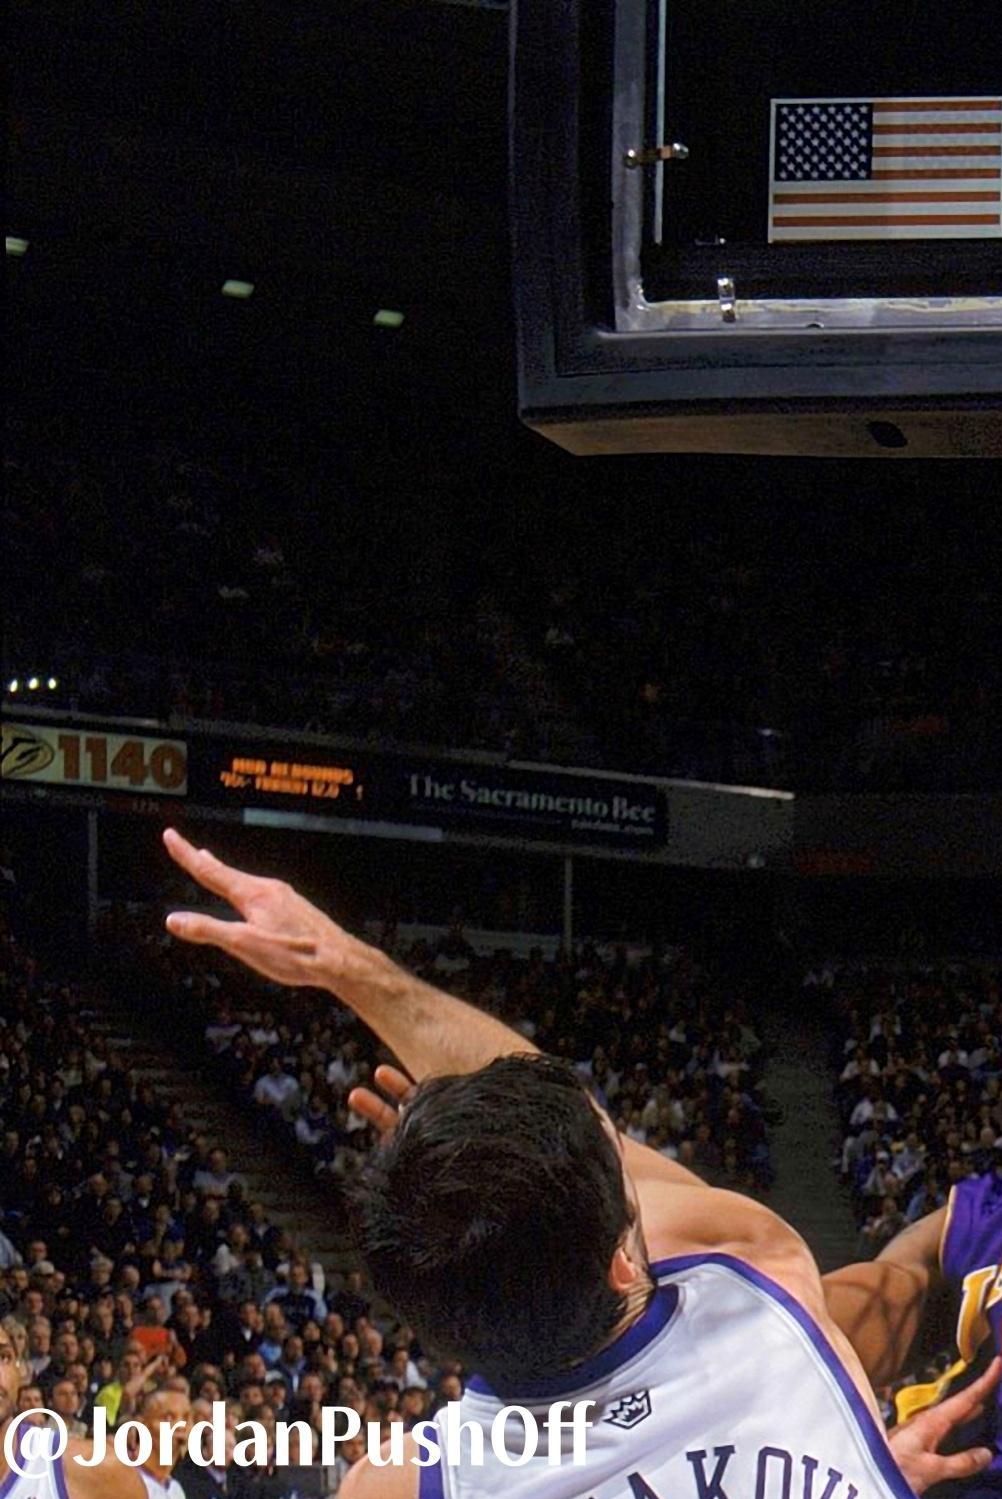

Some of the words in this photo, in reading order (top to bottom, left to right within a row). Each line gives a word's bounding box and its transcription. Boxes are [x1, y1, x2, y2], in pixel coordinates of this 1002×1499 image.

[58, 734, 187, 790] 1140
[408, 773, 454, 799] The
[460, 779, 609, 817] Sacramento
[612, 796, 656, 822] Bee
